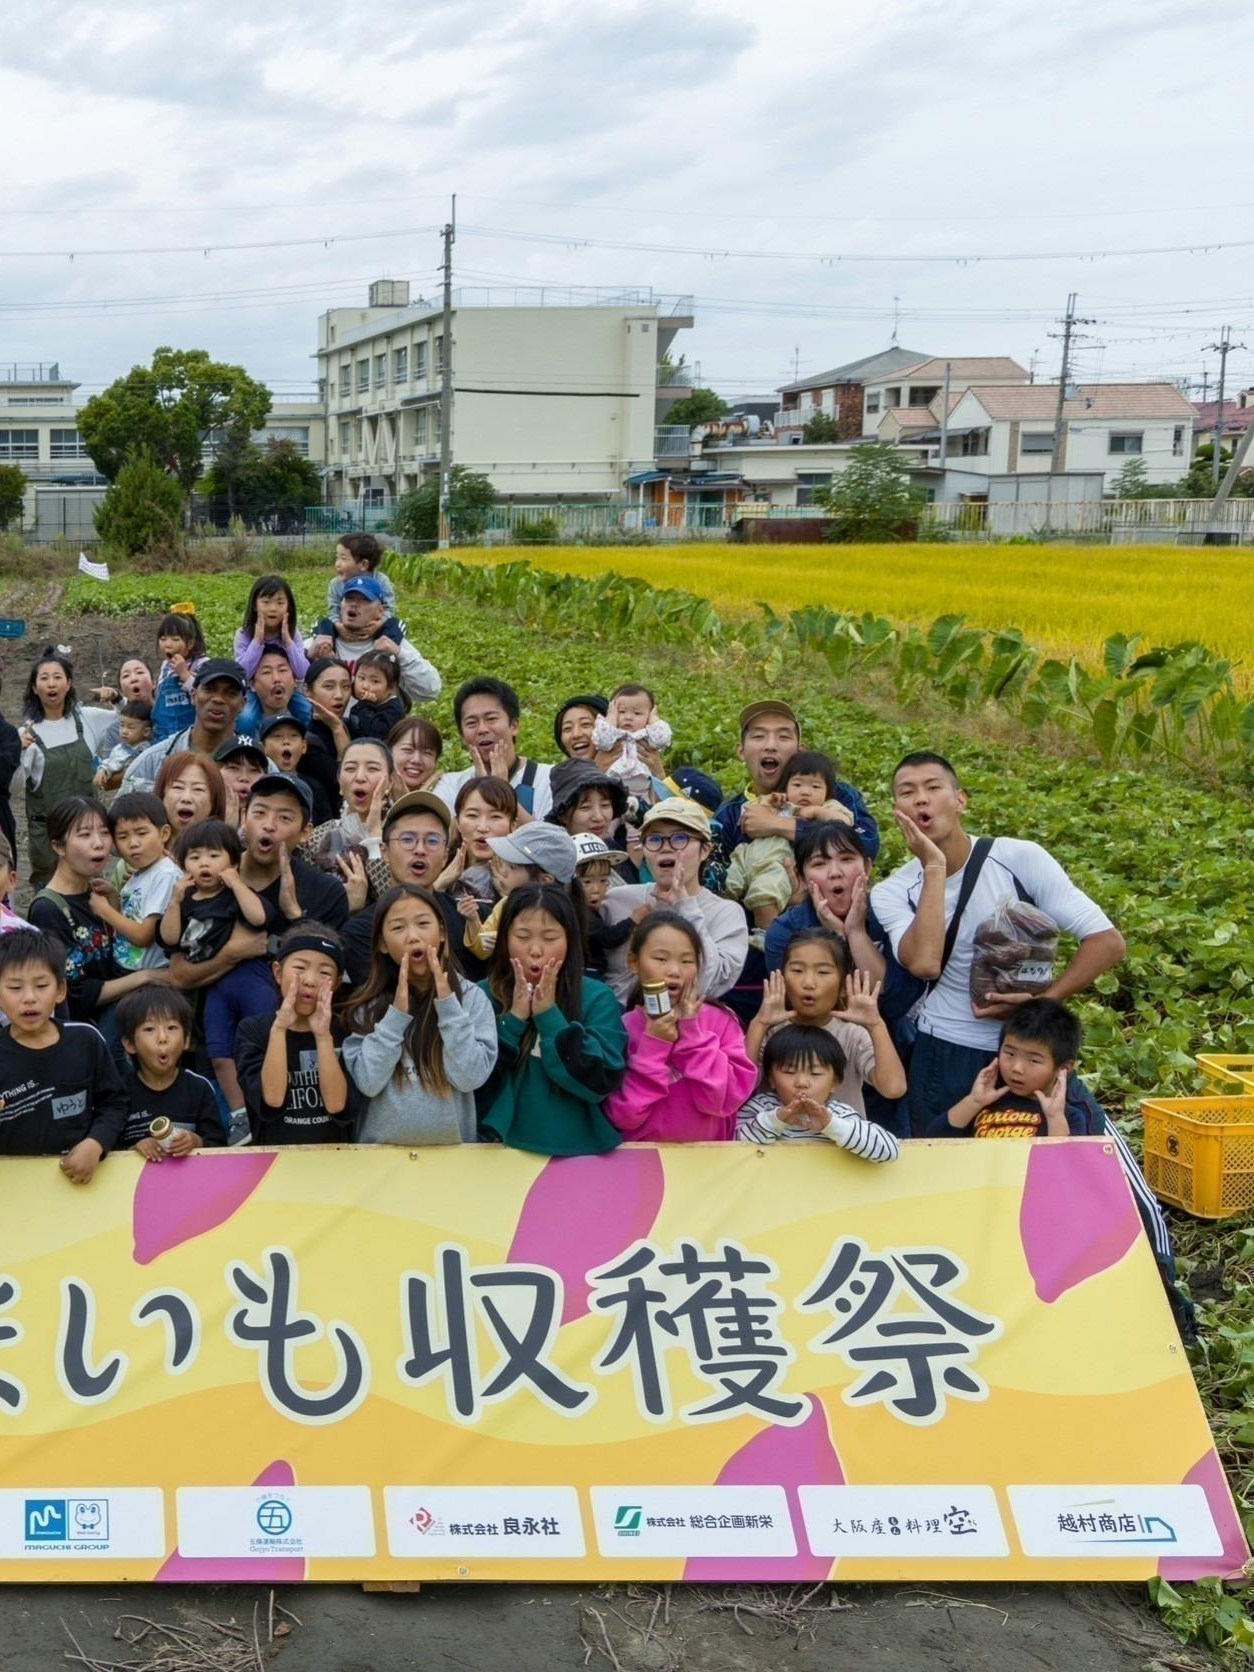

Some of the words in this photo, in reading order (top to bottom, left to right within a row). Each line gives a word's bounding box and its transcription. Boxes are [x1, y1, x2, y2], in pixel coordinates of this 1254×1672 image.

[449, 1523, 499, 1536] 株式会社
[502, 1516, 561, 1536] 良永社
[646, 1517, 686, 1528] 株式会社
[689, 1514, 774, 1530] 総合企画新栄
[1057, 1513, 1137, 1533] 越村商店
